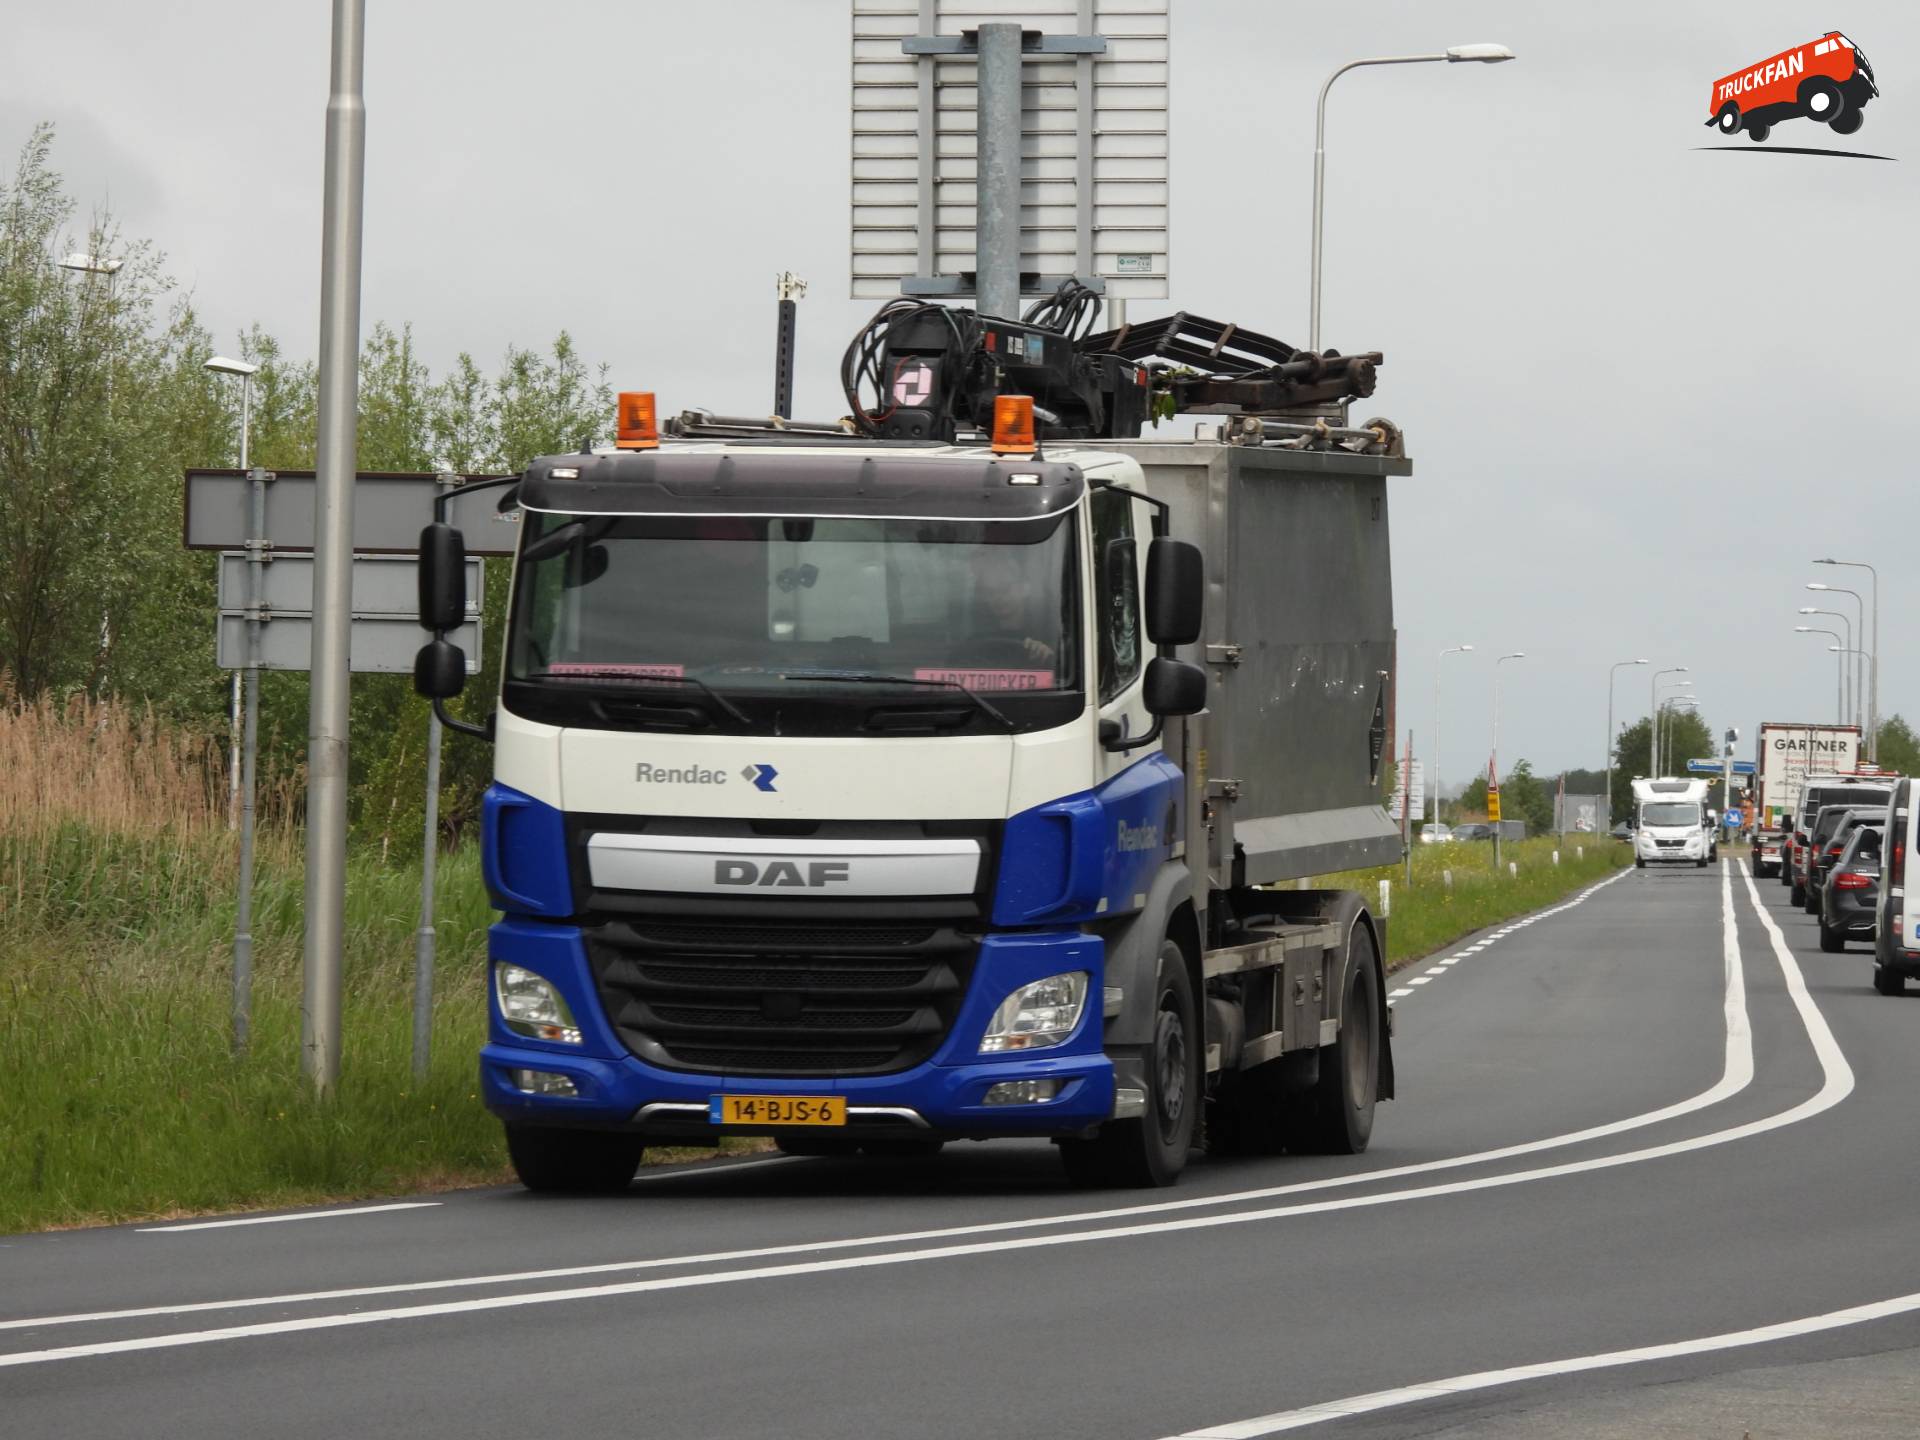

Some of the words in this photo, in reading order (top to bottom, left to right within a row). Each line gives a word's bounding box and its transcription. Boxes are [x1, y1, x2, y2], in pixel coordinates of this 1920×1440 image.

[1774, 739, 1847, 752] GARTNER
[636, 762, 727, 784] Rendac
[715, 860, 849, 887] DAF
[733, 1100, 832, 1121] 14-BJS-6
